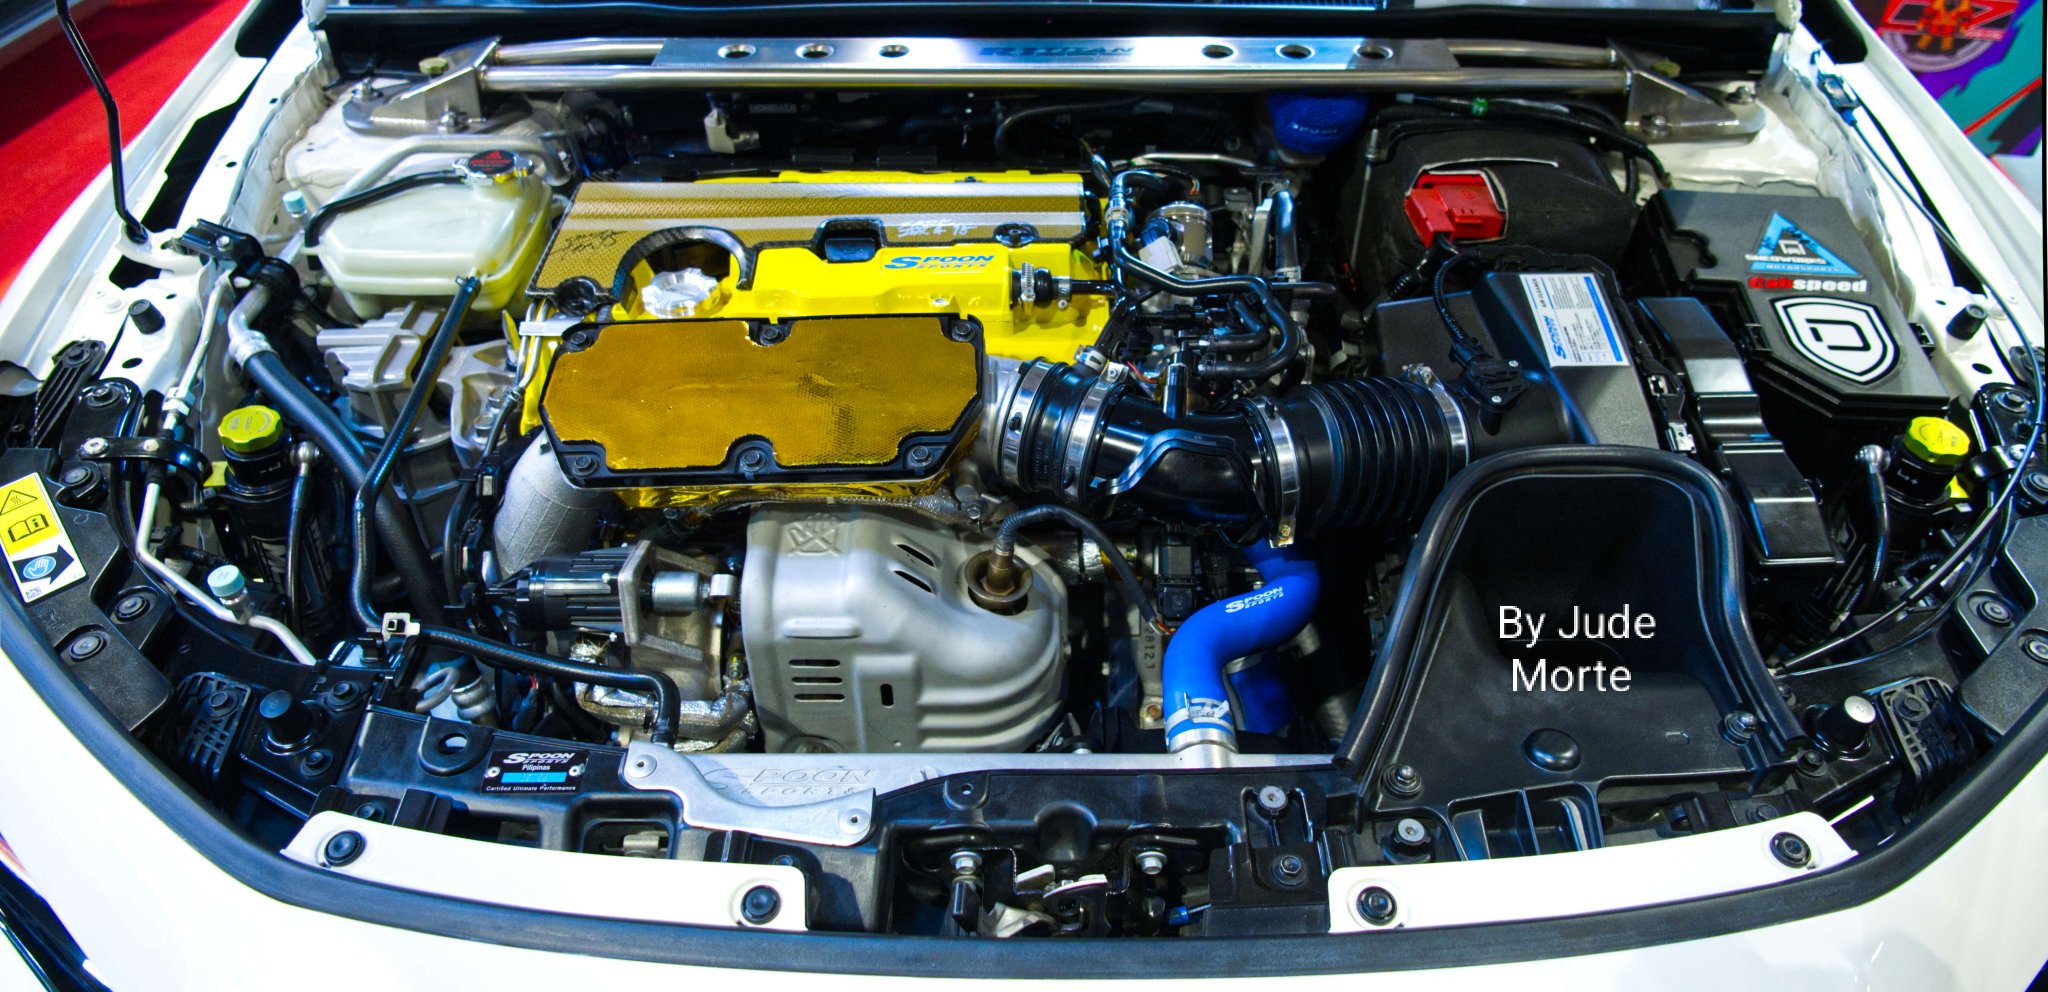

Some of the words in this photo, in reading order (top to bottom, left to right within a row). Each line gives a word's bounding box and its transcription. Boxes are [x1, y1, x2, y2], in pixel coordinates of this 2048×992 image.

[884, 254, 995, 269] SPOON
[1750, 277, 1868, 292] Cabspeed
[1225, 586, 1283, 613] SPOON
[503, 752, 576, 764] SPOON
[522, 764, 551, 772] Pilipinas
